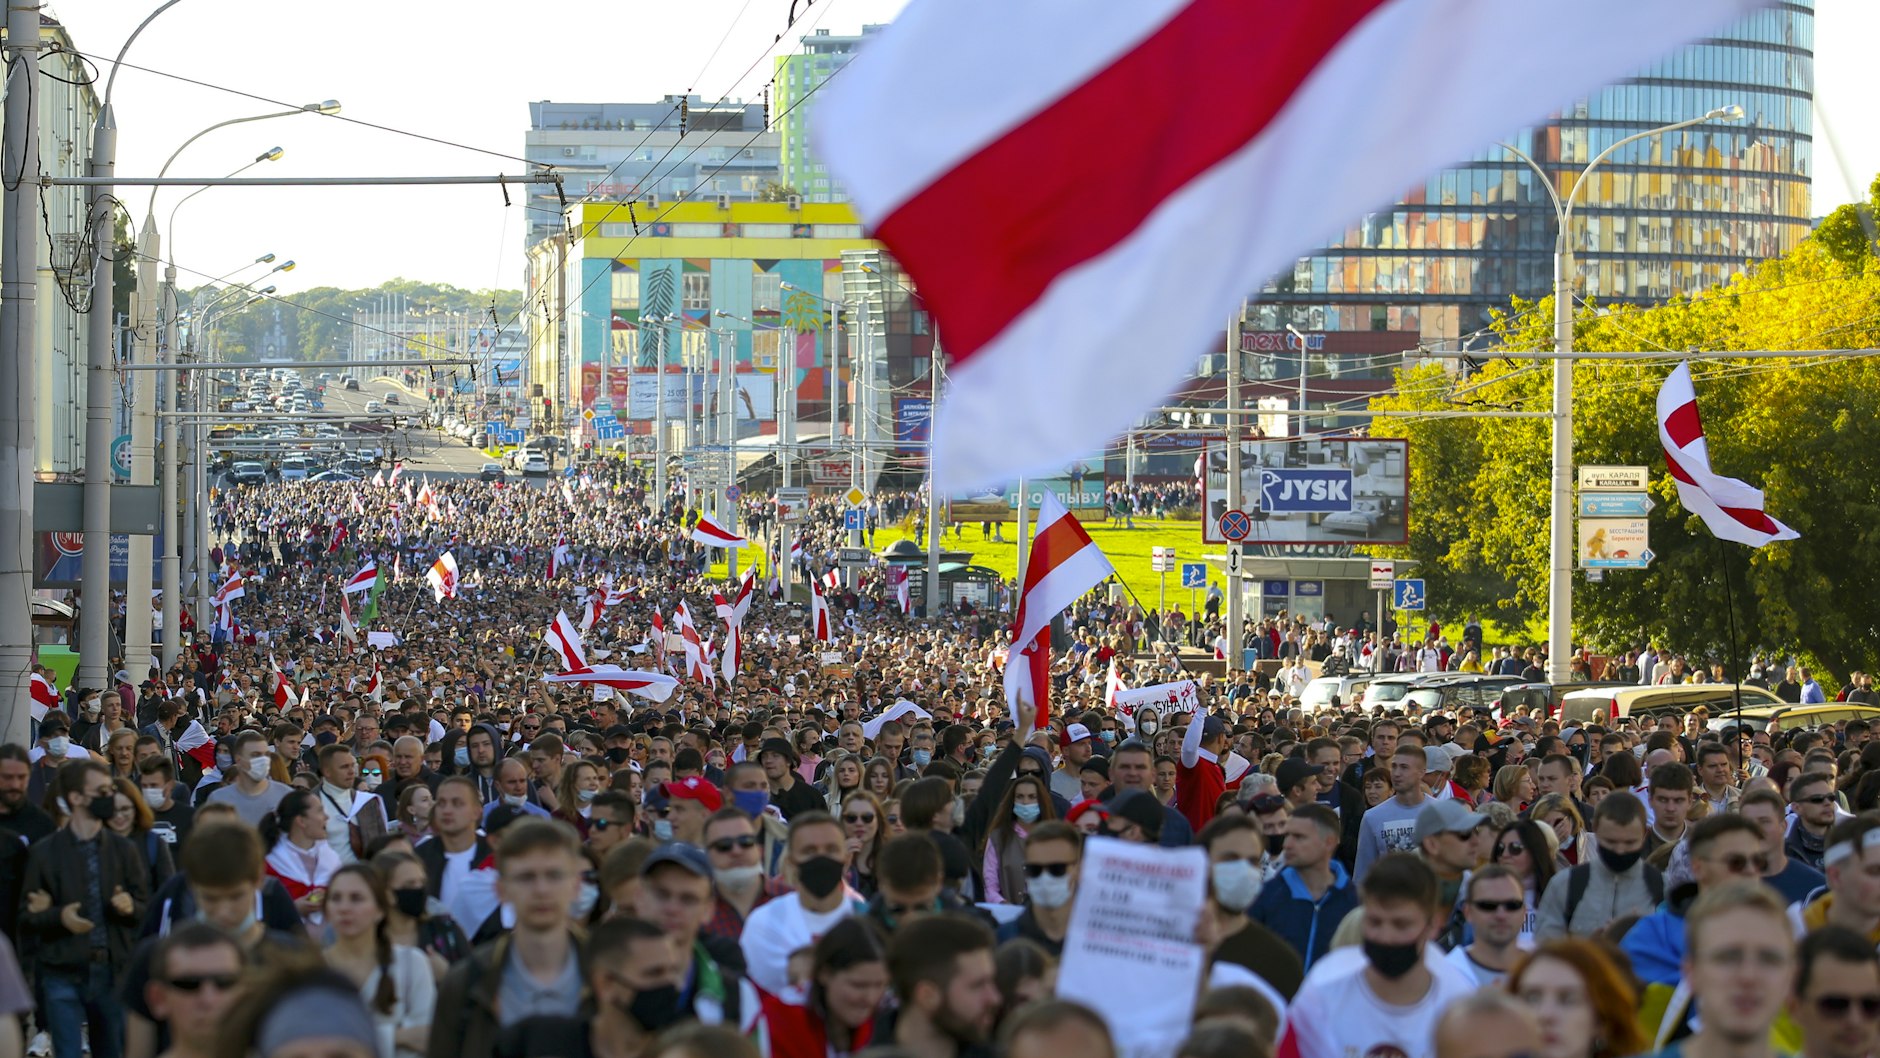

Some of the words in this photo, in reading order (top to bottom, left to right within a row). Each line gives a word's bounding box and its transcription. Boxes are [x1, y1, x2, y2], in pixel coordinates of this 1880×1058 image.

[1242, 332, 1283, 351] nex
[1010, 492, 1101, 504] ПОЛЫВУ
[1279, 479, 1348, 501] JYSK
